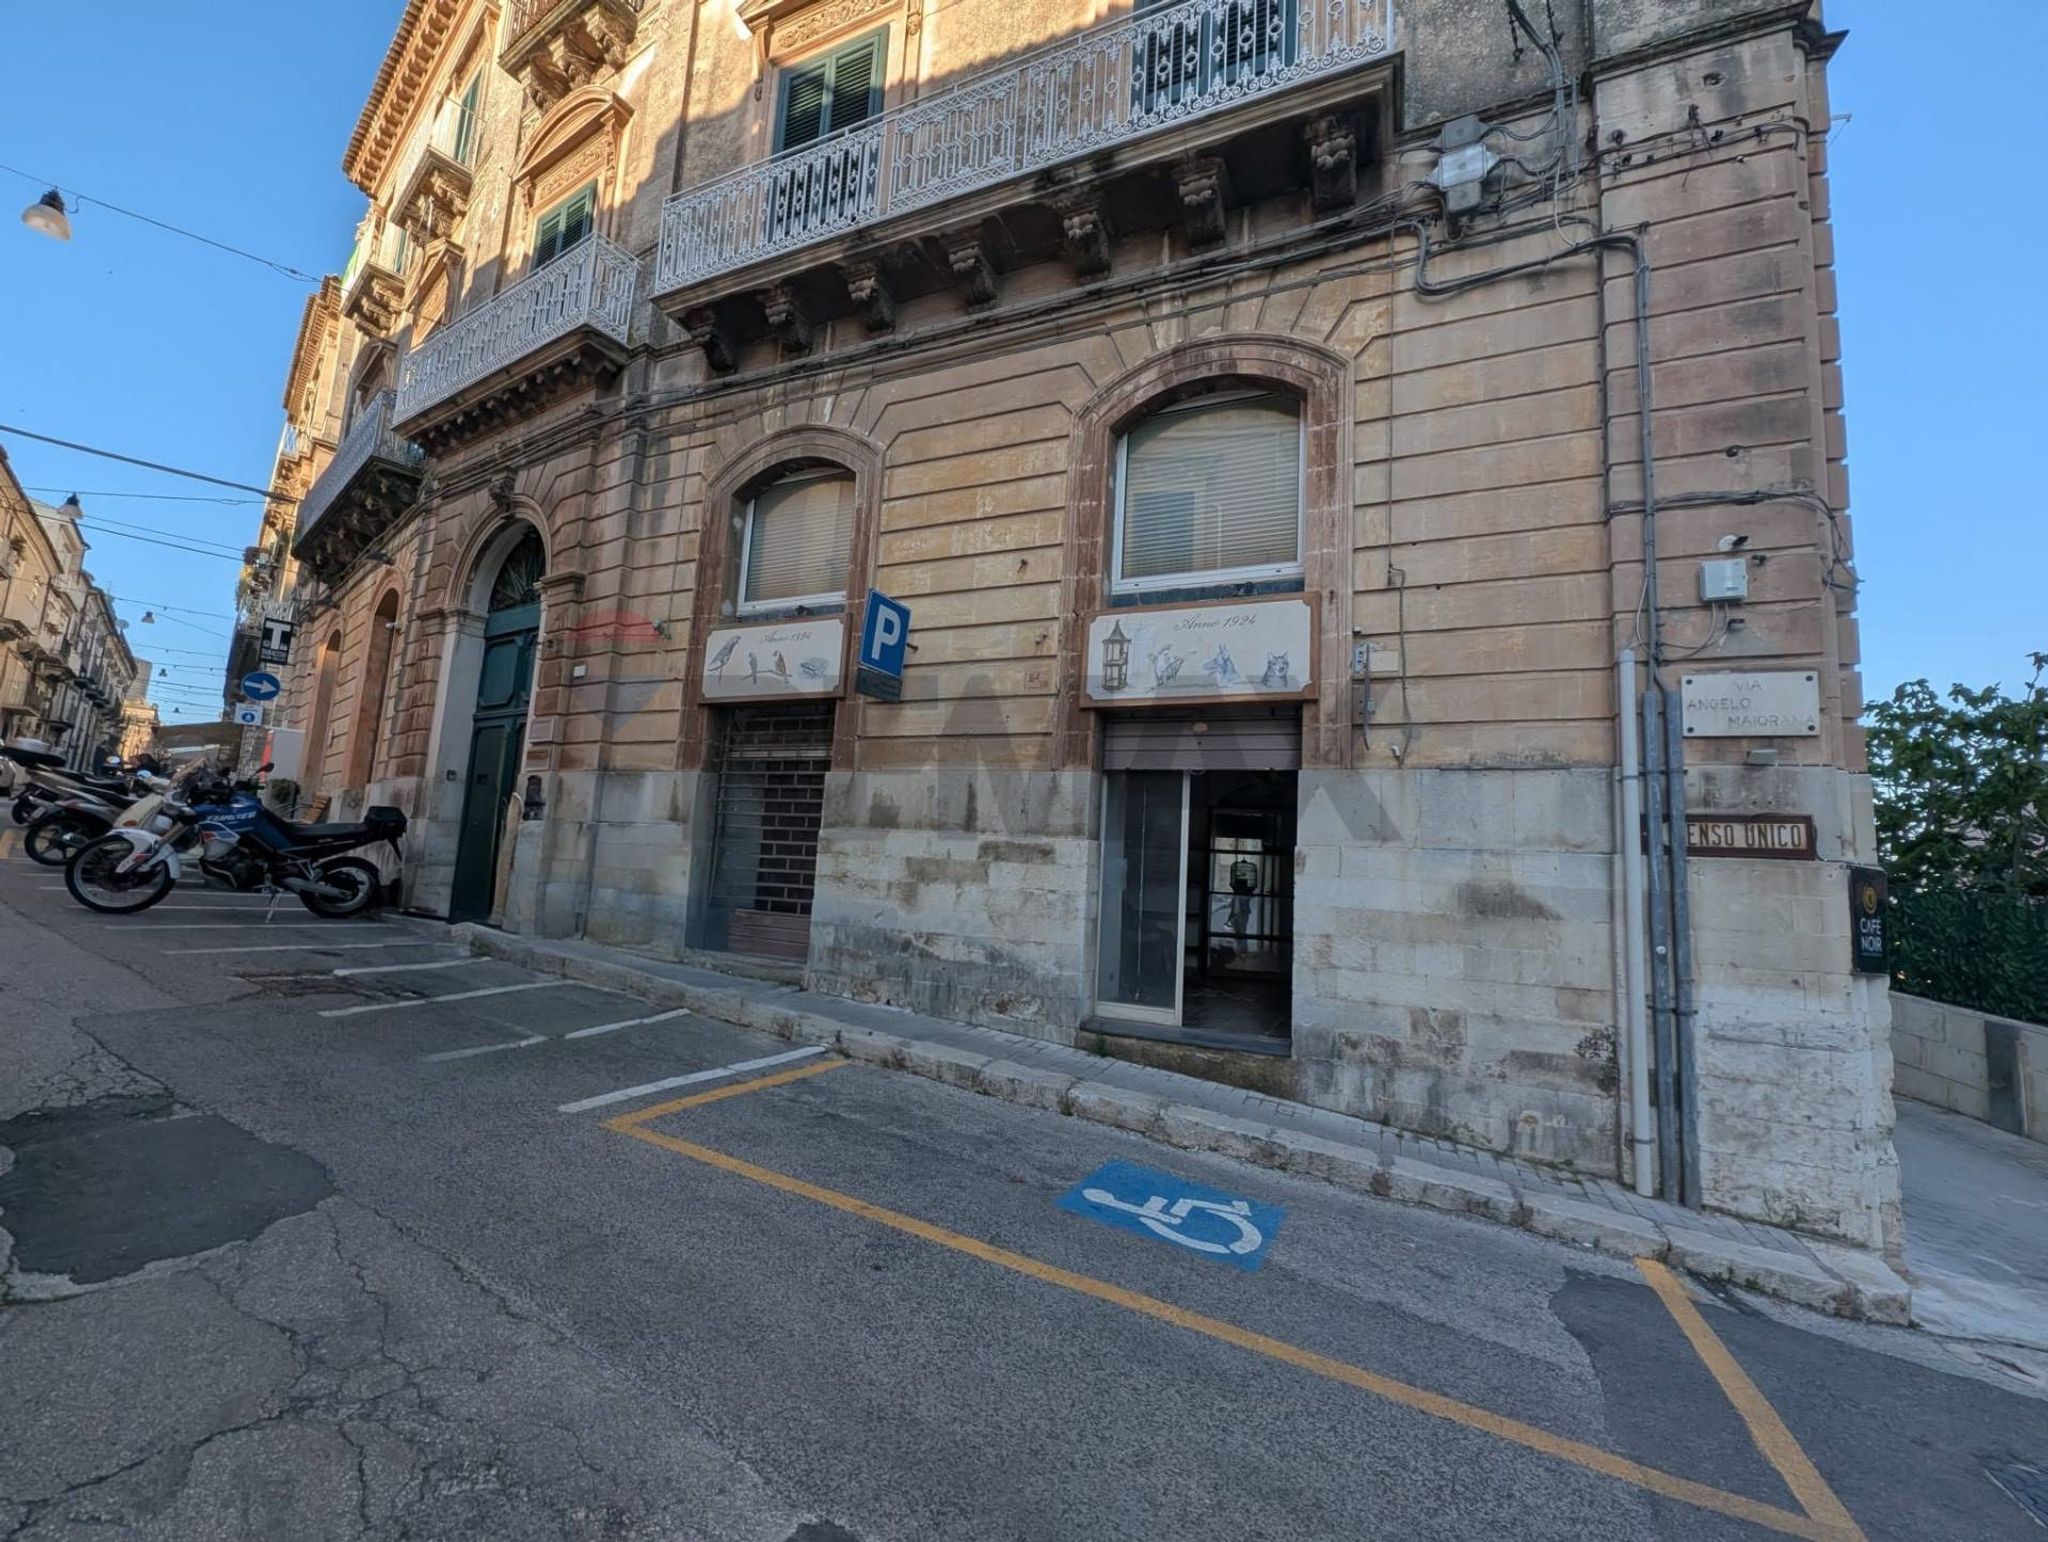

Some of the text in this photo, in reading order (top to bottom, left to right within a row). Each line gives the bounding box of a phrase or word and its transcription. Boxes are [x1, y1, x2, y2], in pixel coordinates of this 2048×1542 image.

[264, 620, 291, 650] T
[871, 604, 901, 661] P
[1735, 680, 1762, 693] VIA
[1686, 697, 1752, 711] ANGELO
[1686, 822, 1802, 849] ENSO UNICO
[1861, 935, 1883, 953] NOIR
